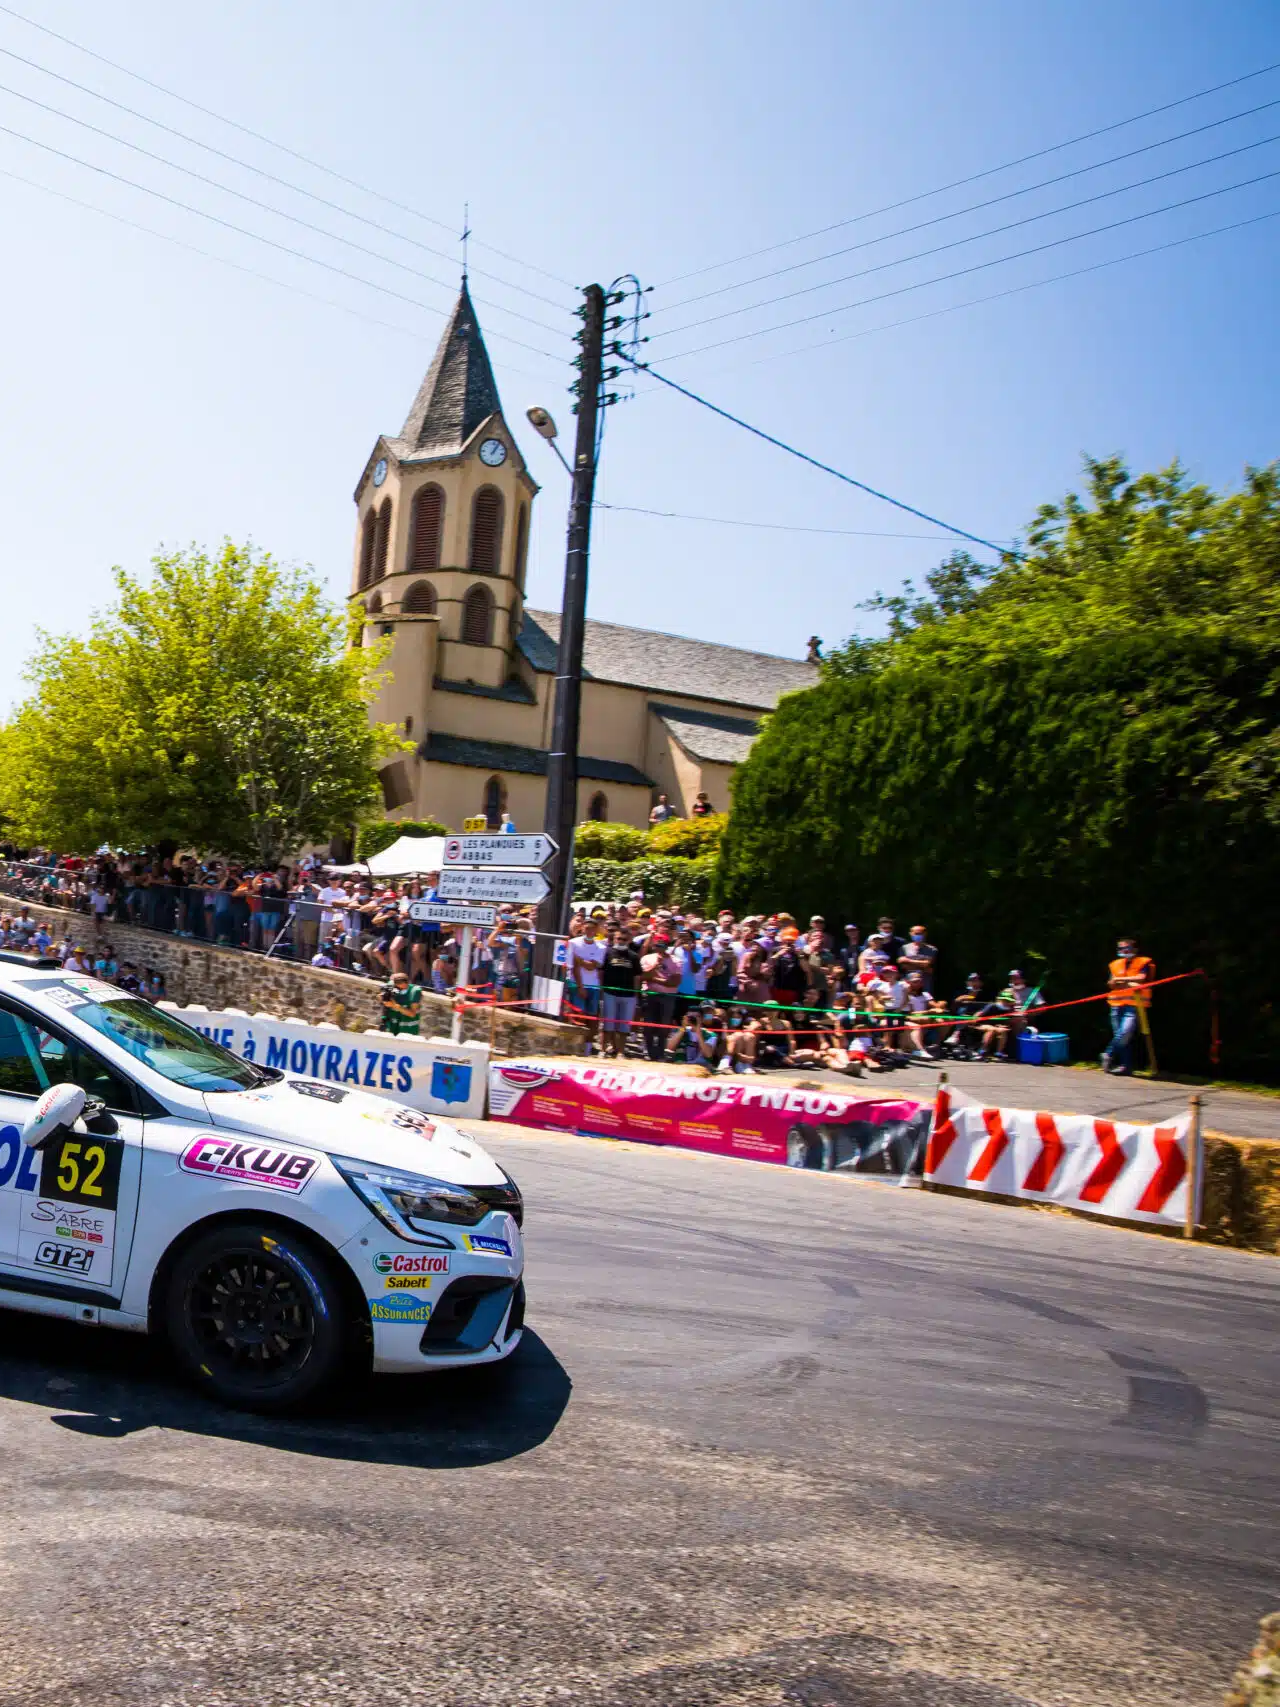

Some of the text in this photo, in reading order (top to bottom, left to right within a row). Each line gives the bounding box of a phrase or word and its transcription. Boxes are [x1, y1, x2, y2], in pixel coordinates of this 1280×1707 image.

[462, 839, 478, 849] LES
[533, 839, 542, 849] 6
[461, 851, 541, 862] ABBAS 7
[427, 907, 493, 921] BARAQUEVILLE
[266, 1036, 413, 1093] MOYRAZES
[57, 1142, 107, 1197] 52
[479, 1240, 508, 1252] MICHELIN
[35, 1241, 95, 1272] GT2i
[392, 1254, 449, 1273] Castrol
[387, 1276, 428, 1289] Sabelt
[371, 1302, 431, 1321] ASSURANCES
